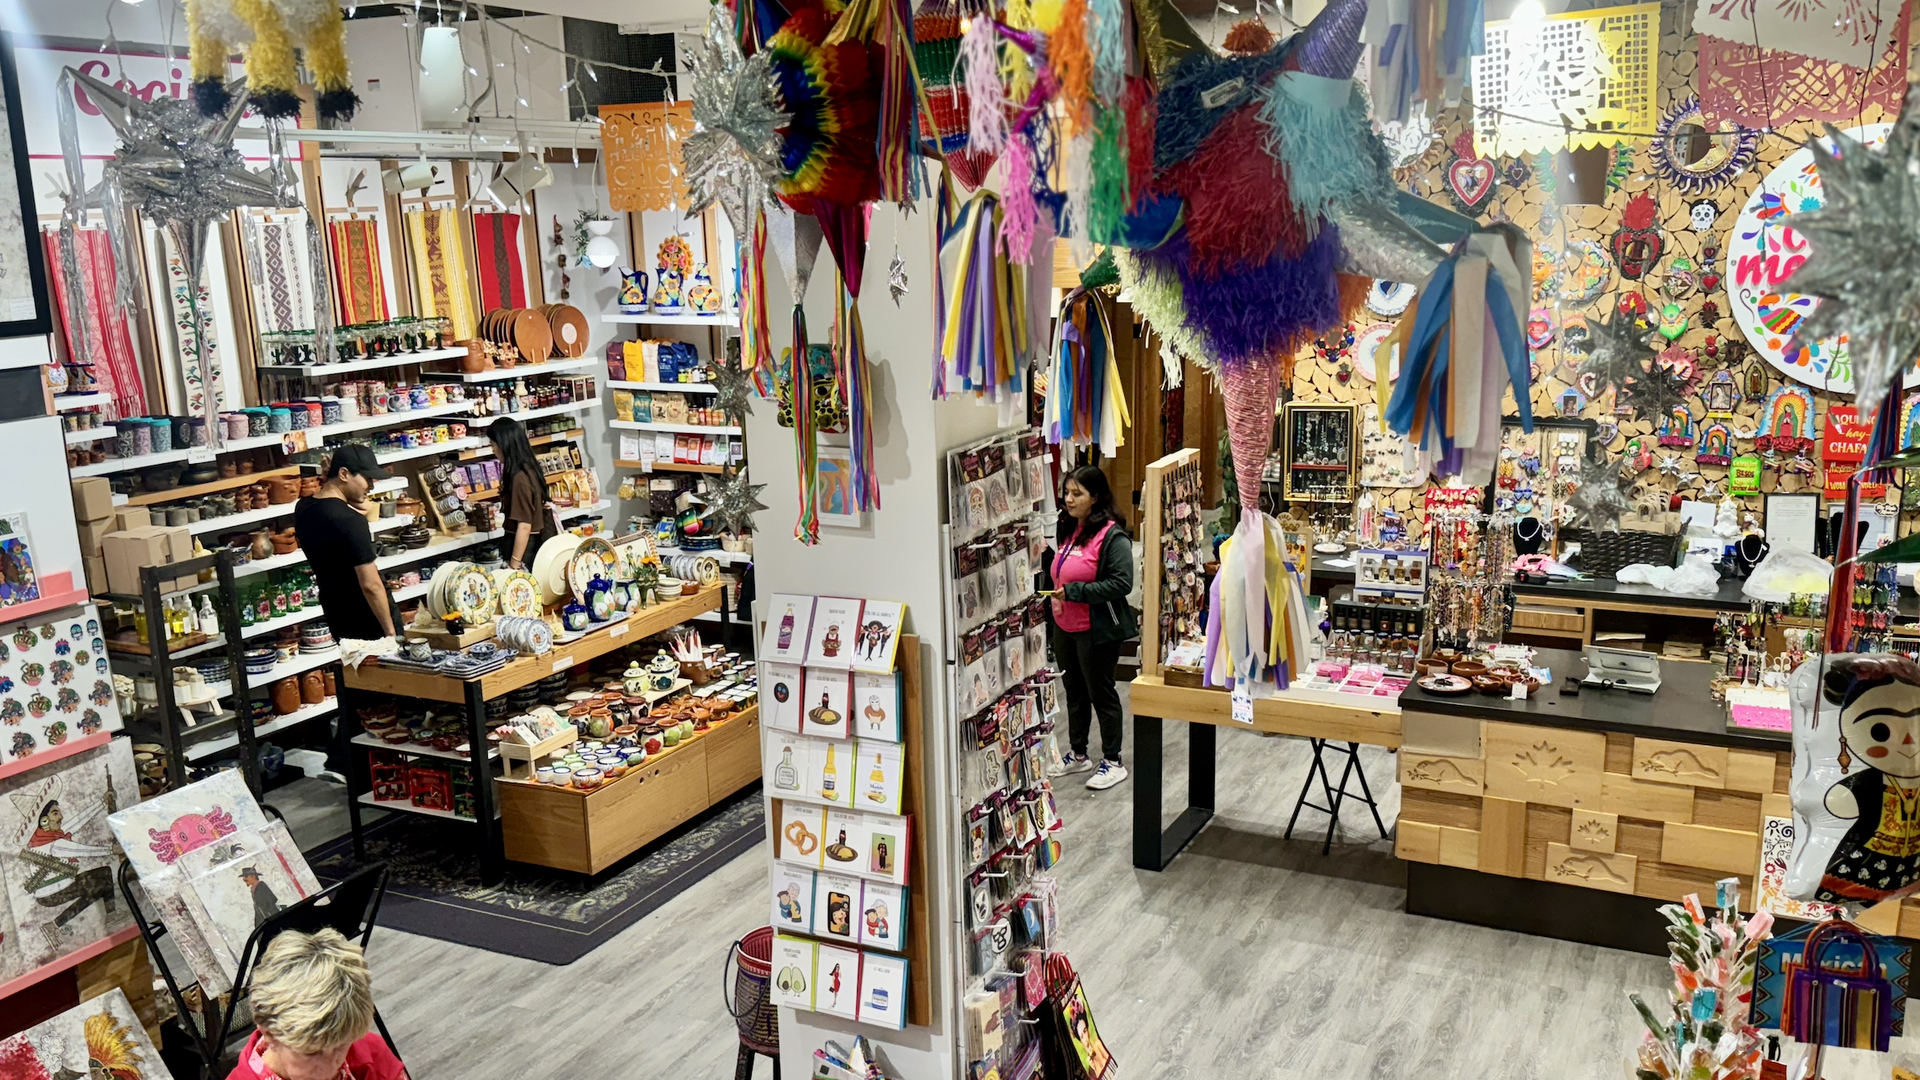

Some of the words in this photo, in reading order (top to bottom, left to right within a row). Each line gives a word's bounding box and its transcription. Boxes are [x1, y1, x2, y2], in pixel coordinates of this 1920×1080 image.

[73, 60, 199, 116] Coci
[1829, 441, 1868, 454] CHAFA
[1780, 952, 1888, 980] Mxicn
